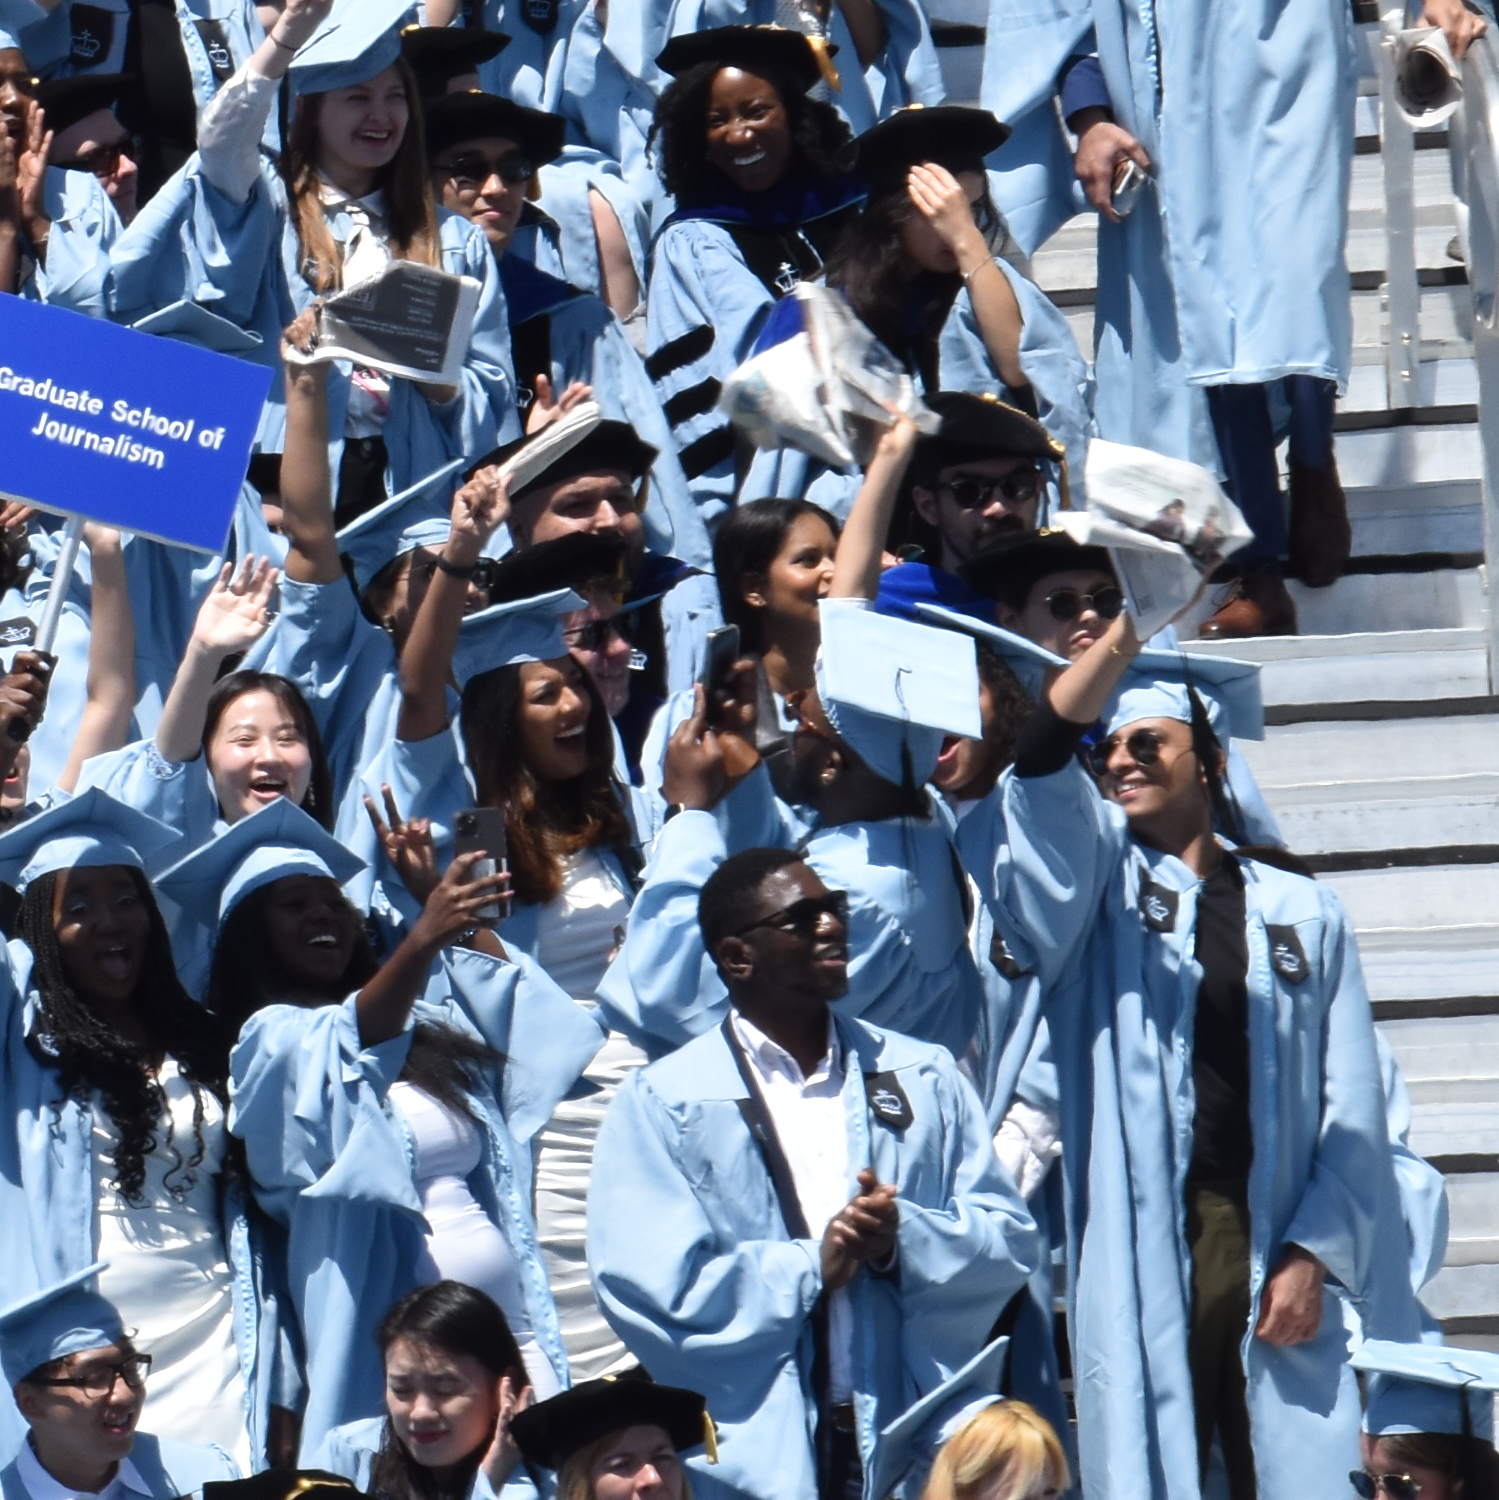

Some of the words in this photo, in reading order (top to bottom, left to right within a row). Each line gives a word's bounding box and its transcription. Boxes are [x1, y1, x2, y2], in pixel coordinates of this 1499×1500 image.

[31, 412, 165, 470] Journalism
[110, 399, 195, 441] School
[198, 426, 226, 450] of
